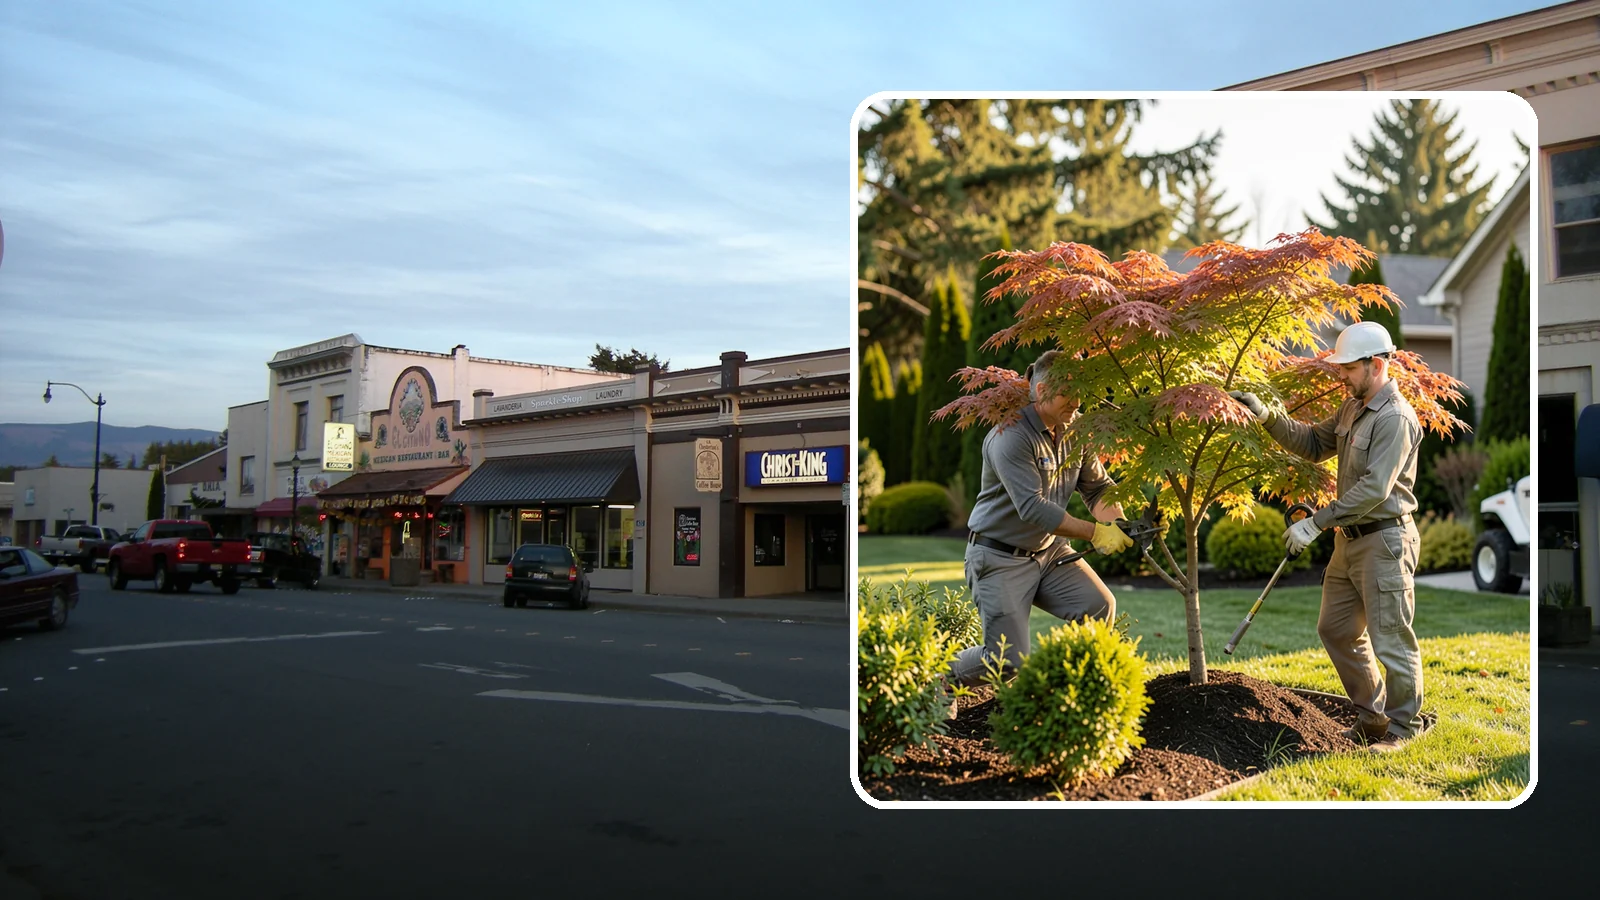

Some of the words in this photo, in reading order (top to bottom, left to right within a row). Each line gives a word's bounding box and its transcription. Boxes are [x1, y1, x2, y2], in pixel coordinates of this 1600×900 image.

[596, 389, 623, 399] LAUNDRY
[493, 402, 522, 412] LAVANDERIA
[531, 396, 561, 409] Sparkle
[562, 394, 582, 404] Shop
[373, 455, 396, 464] MEXICAN
[397, 451, 433, 462] RESTAURANT
[438, 450, 450, 459] BAR
[761, 452, 797, 478] CHRIST
[799, 450, 827, 476] KING
[696, 480, 709, 488] Coffee
[710, 480, 721, 489] House
